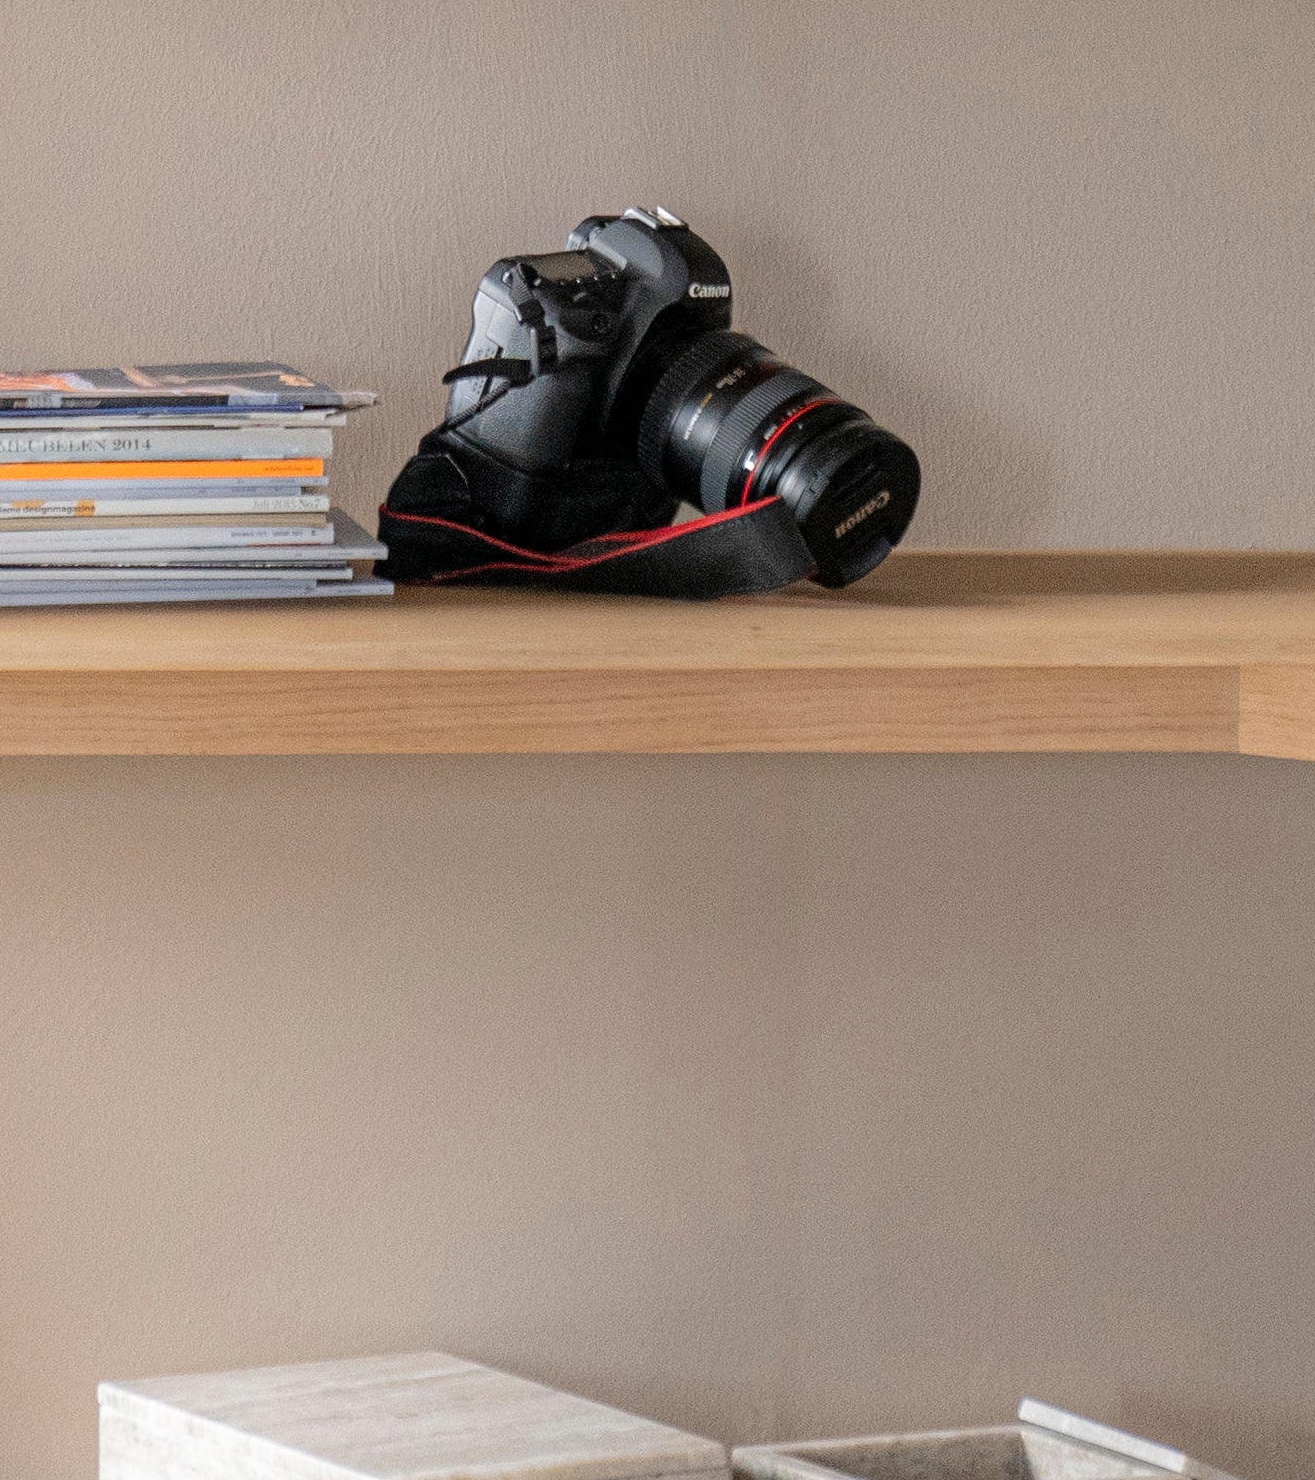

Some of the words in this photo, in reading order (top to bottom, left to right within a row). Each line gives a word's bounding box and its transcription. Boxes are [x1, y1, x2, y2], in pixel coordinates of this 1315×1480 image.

[688, 282, 730, 298] Canon
[112, 438, 152, 451] 2014
[23, 505, 96, 516] designmagazine
[835, 490, 891, 539] Canon
